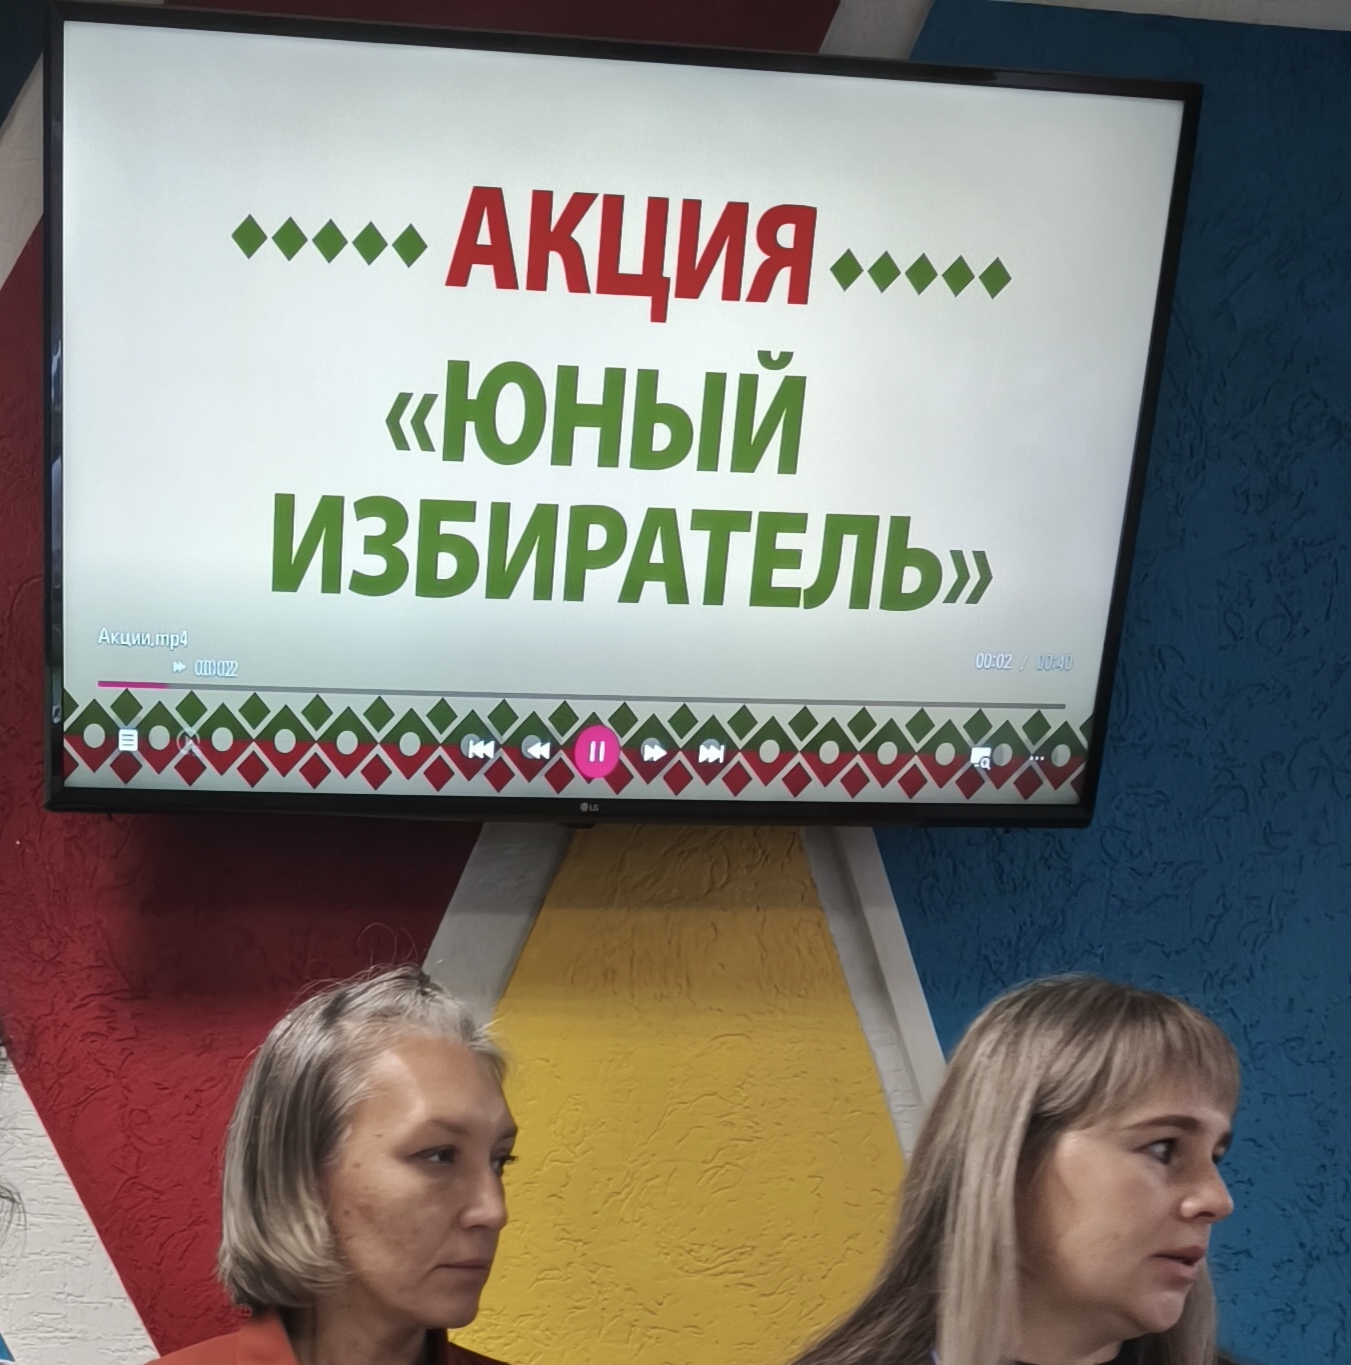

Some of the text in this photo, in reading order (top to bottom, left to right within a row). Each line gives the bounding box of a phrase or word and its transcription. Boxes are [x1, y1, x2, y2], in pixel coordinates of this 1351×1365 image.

[445, 186, 817, 323] АКЦИЯ
[386, 351, 806, 475] «ЮНЫЙ
[271, 493, 993, 611] ИЗБИРАТЕЛЬ»
[98, 627, 188, 650] Акции.mp4
[976, 652, 1012, 669] 00:02
